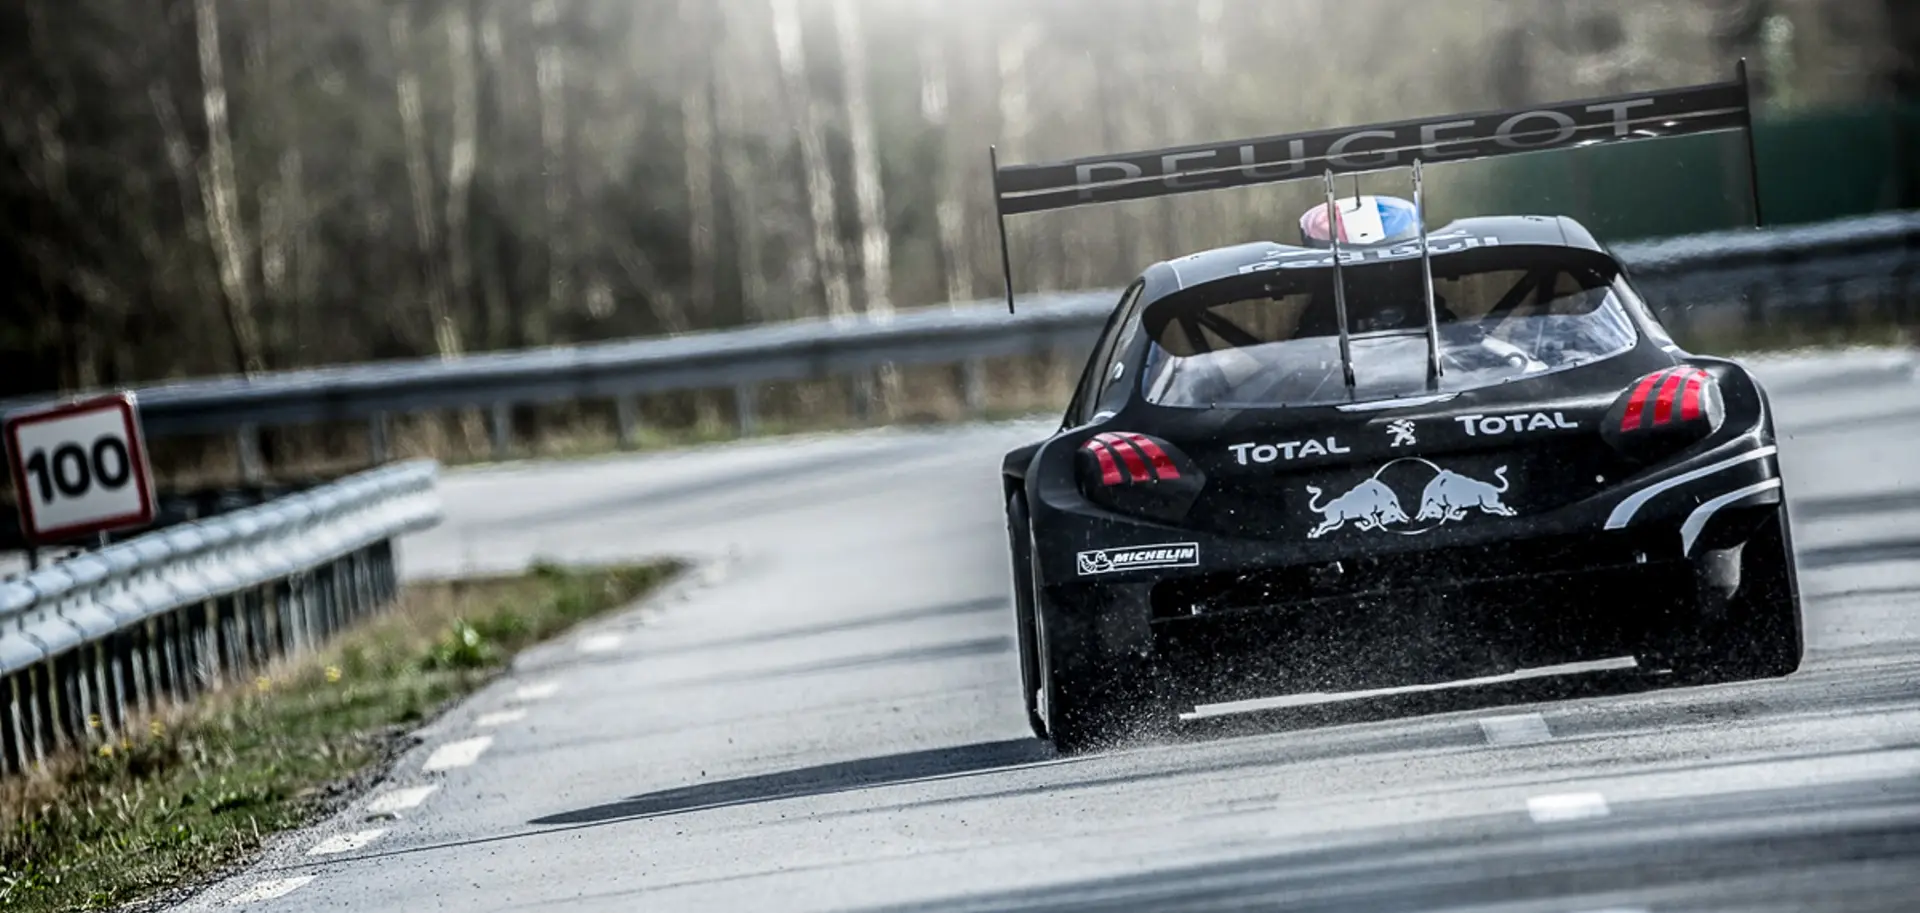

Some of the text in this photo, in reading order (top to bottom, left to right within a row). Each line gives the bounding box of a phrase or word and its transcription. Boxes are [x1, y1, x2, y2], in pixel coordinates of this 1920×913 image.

[1076, 98, 1654, 199] PEUGEOT
[1455, 412, 1578, 436] TOTAL
[1228, 436, 1350, 465] TOTAL
[27, 434, 130, 504] 100
[1113, 548, 1195, 563] MICHELIN
